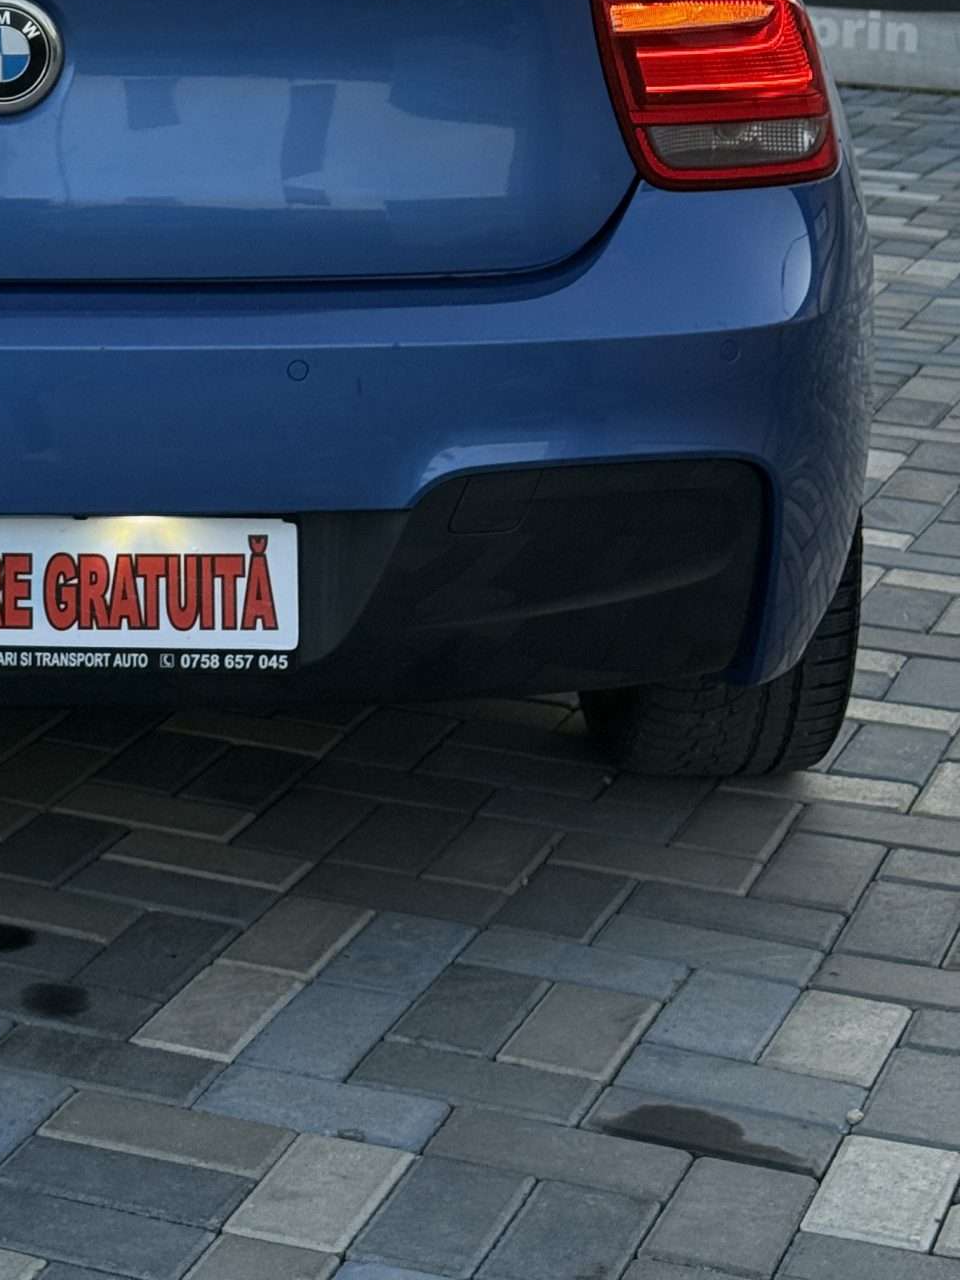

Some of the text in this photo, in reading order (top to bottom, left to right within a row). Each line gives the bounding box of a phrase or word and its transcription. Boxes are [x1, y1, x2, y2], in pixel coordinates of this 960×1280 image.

[43, 534, 279, 632] GRATUITĂ
[20, 652, 32, 666] SI
[35, 652, 111, 668] TRANSPORT
[113, 653, 149, 668] AUTO
[180, 653, 220, 669] 0758
[224, 654, 254, 669] 657
[258, 654, 288, 670] 045
